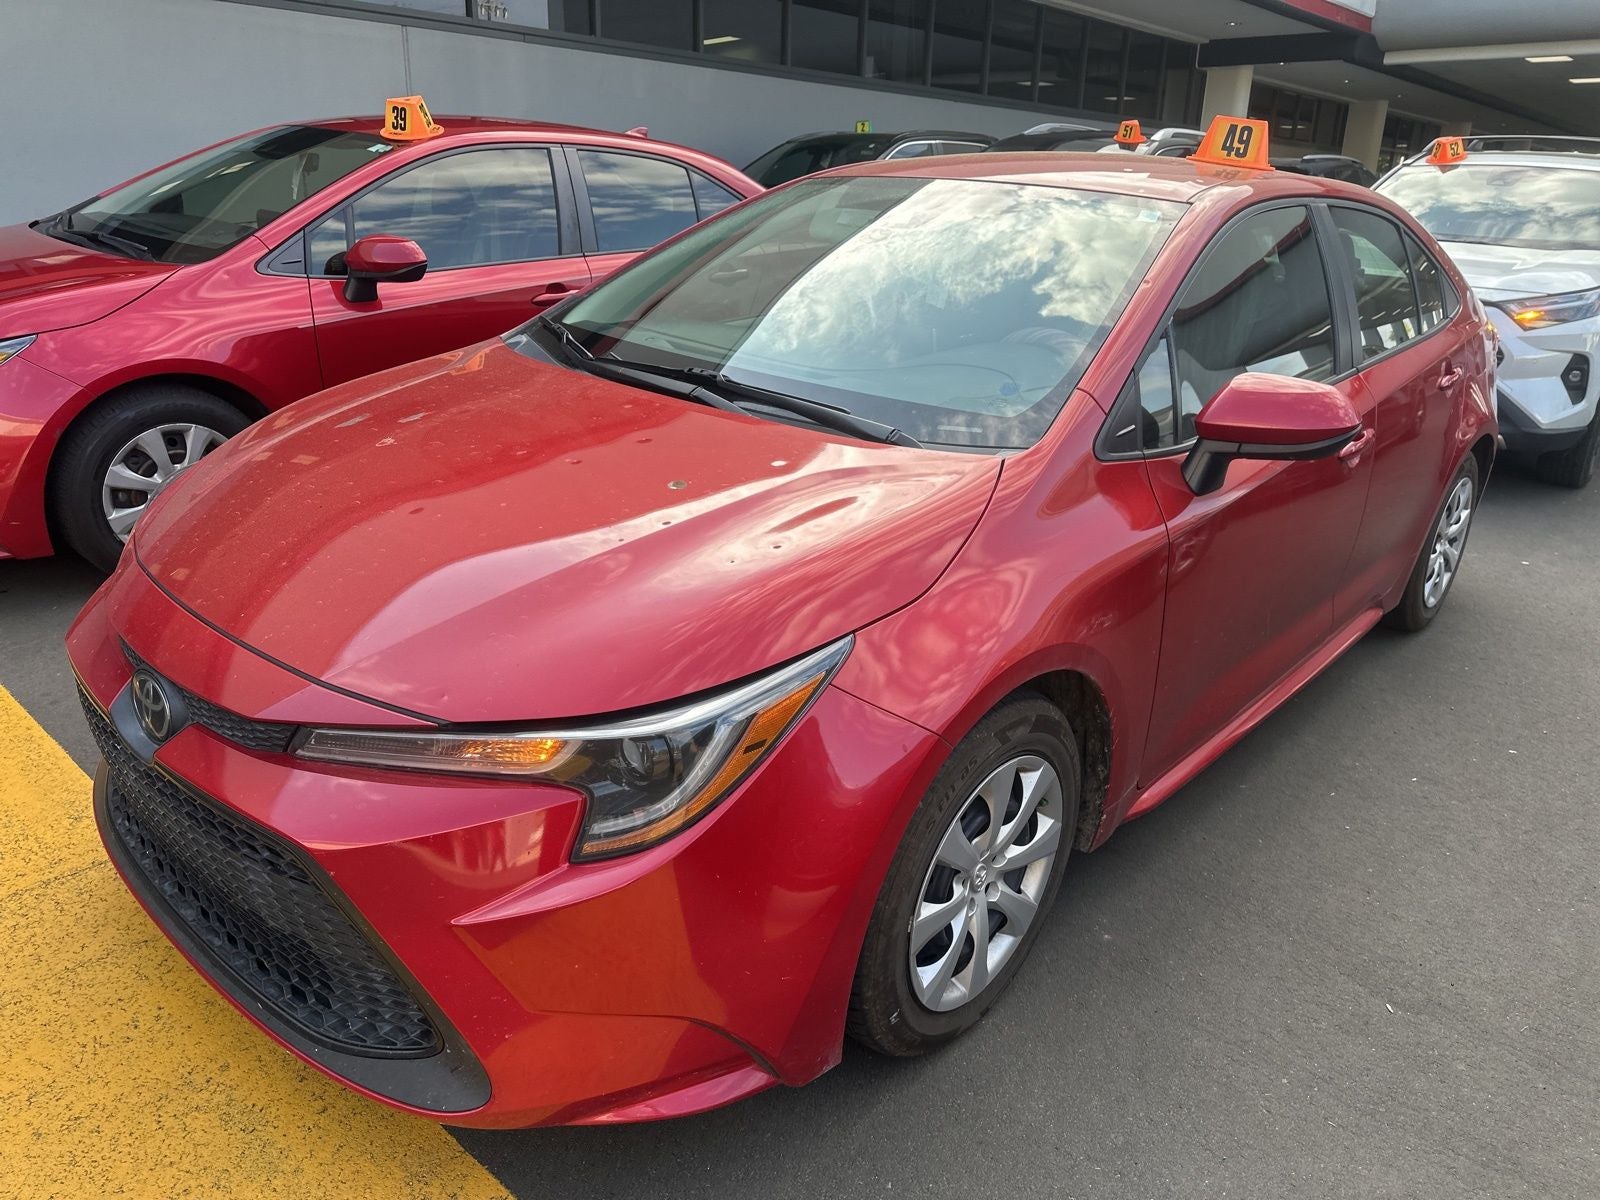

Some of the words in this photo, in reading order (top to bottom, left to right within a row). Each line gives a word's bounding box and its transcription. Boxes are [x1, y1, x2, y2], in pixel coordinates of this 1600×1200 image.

[392, 106, 406, 131] 39
[1123, 125, 1133, 139] 51
[1221, 124, 1253, 158] 49
[1450, 142, 1460, 157] 52
